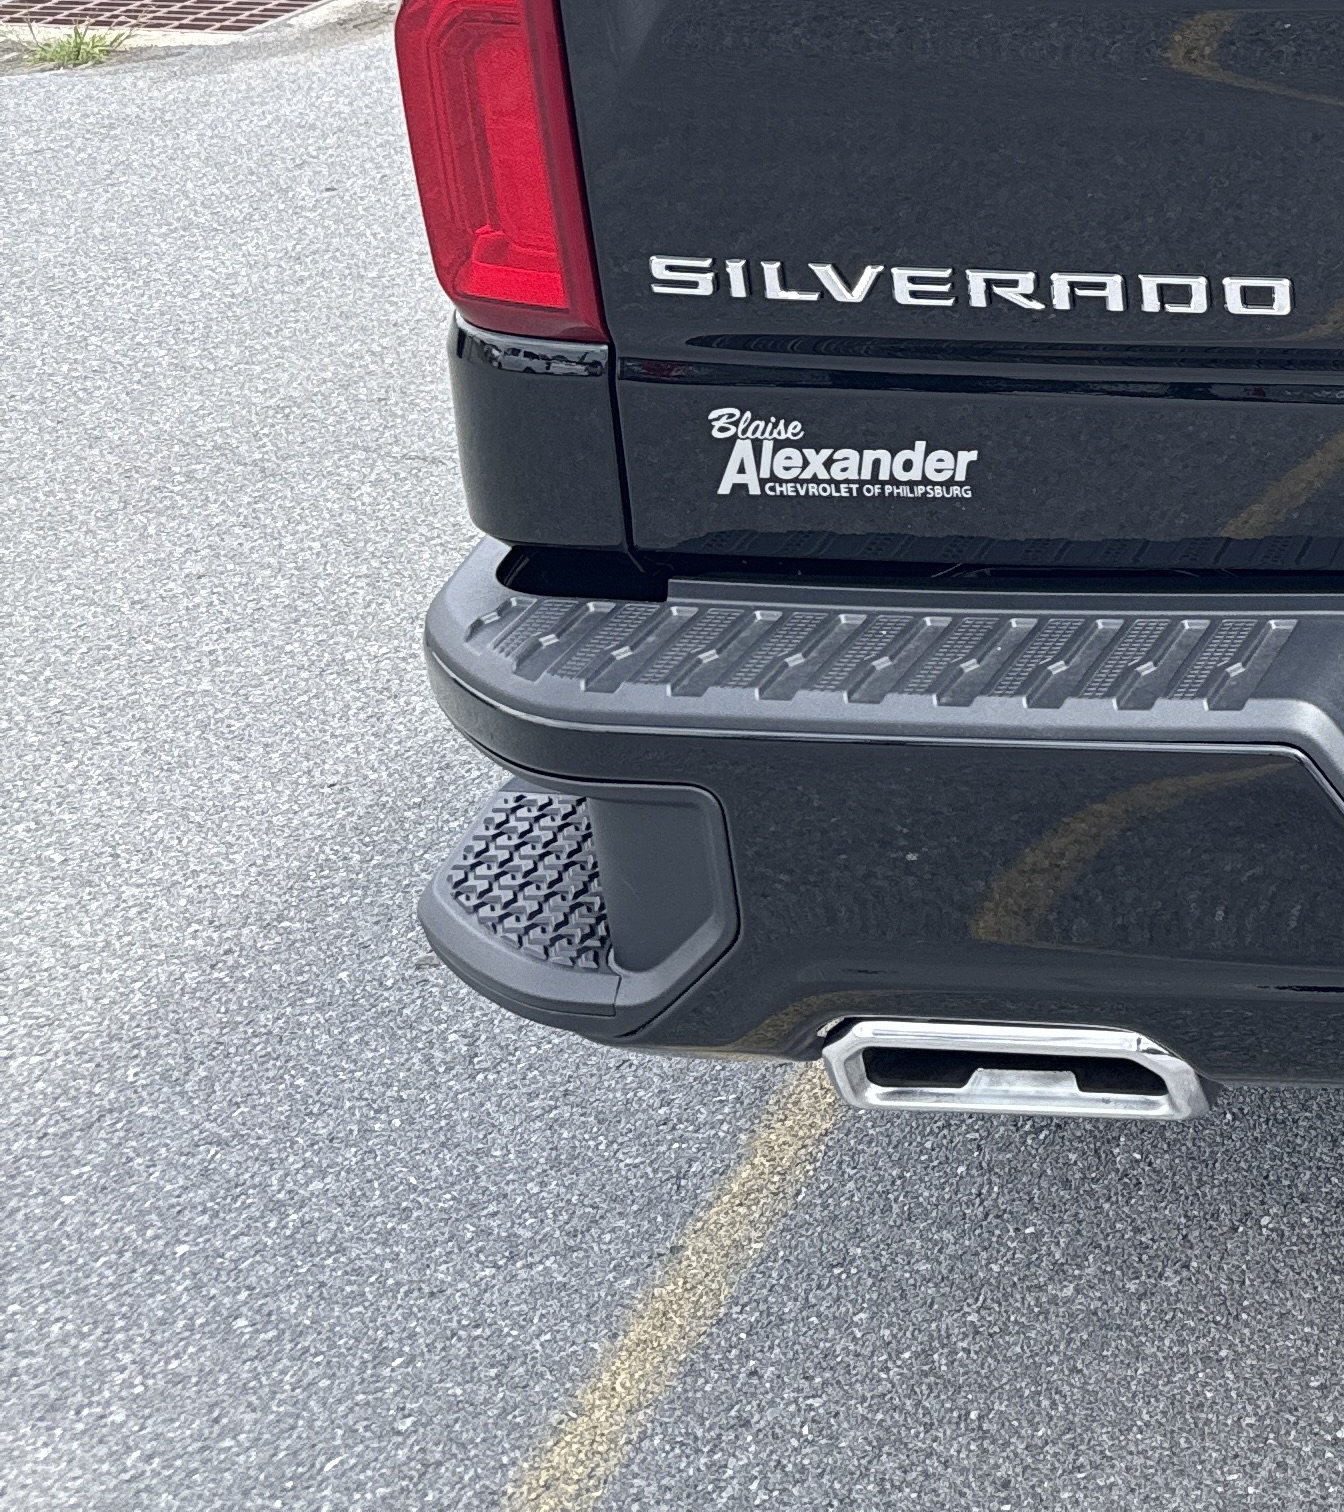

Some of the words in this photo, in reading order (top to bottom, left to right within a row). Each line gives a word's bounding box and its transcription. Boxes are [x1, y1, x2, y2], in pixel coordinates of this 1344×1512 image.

[648, 254, 1294, 316] SILVERADO
[708, 407, 805, 440] Blaise
[717, 439, 979, 495] Alexander
[764, 482, 860, 497] CHEVROLET
[862, 484, 882, 497] OF
[884, 484, 973, 498] PHILIPSBURG
